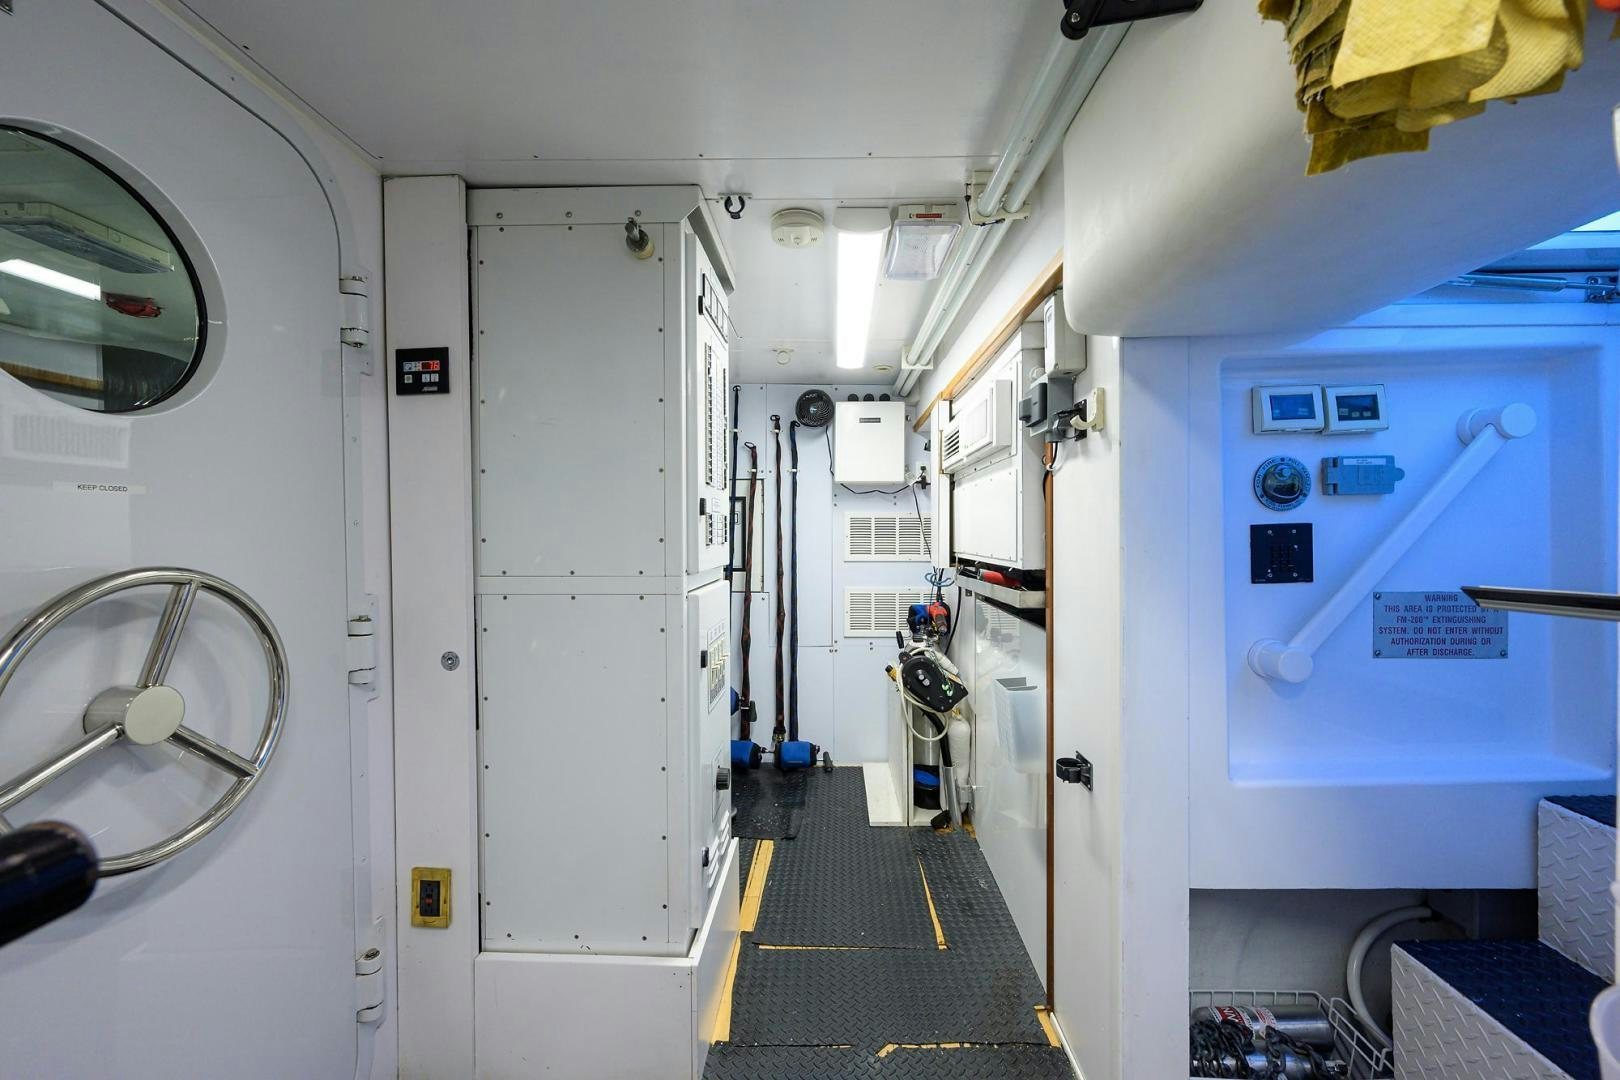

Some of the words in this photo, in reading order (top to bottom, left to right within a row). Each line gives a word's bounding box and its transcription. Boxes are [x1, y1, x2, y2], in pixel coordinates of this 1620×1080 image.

[1437, 605, 1477, 613] PROTECTED
[1432, 616, 1486, 624] EXTINGUISHING
[1413, 626, 1423, 635] DO
[1427, 626, 1441, 635] NOT
[1445, 626, 1468, 635] ENTER
[1471, 626, 1503, 635] WITHOUT
[1391, 637, 1446, 646] AUTHORIZATION
[1450, 637, 1477, 646] DURING
[1481, 637, 1491, 646] OR
[1406, 648, 1429, 656] AFTER
